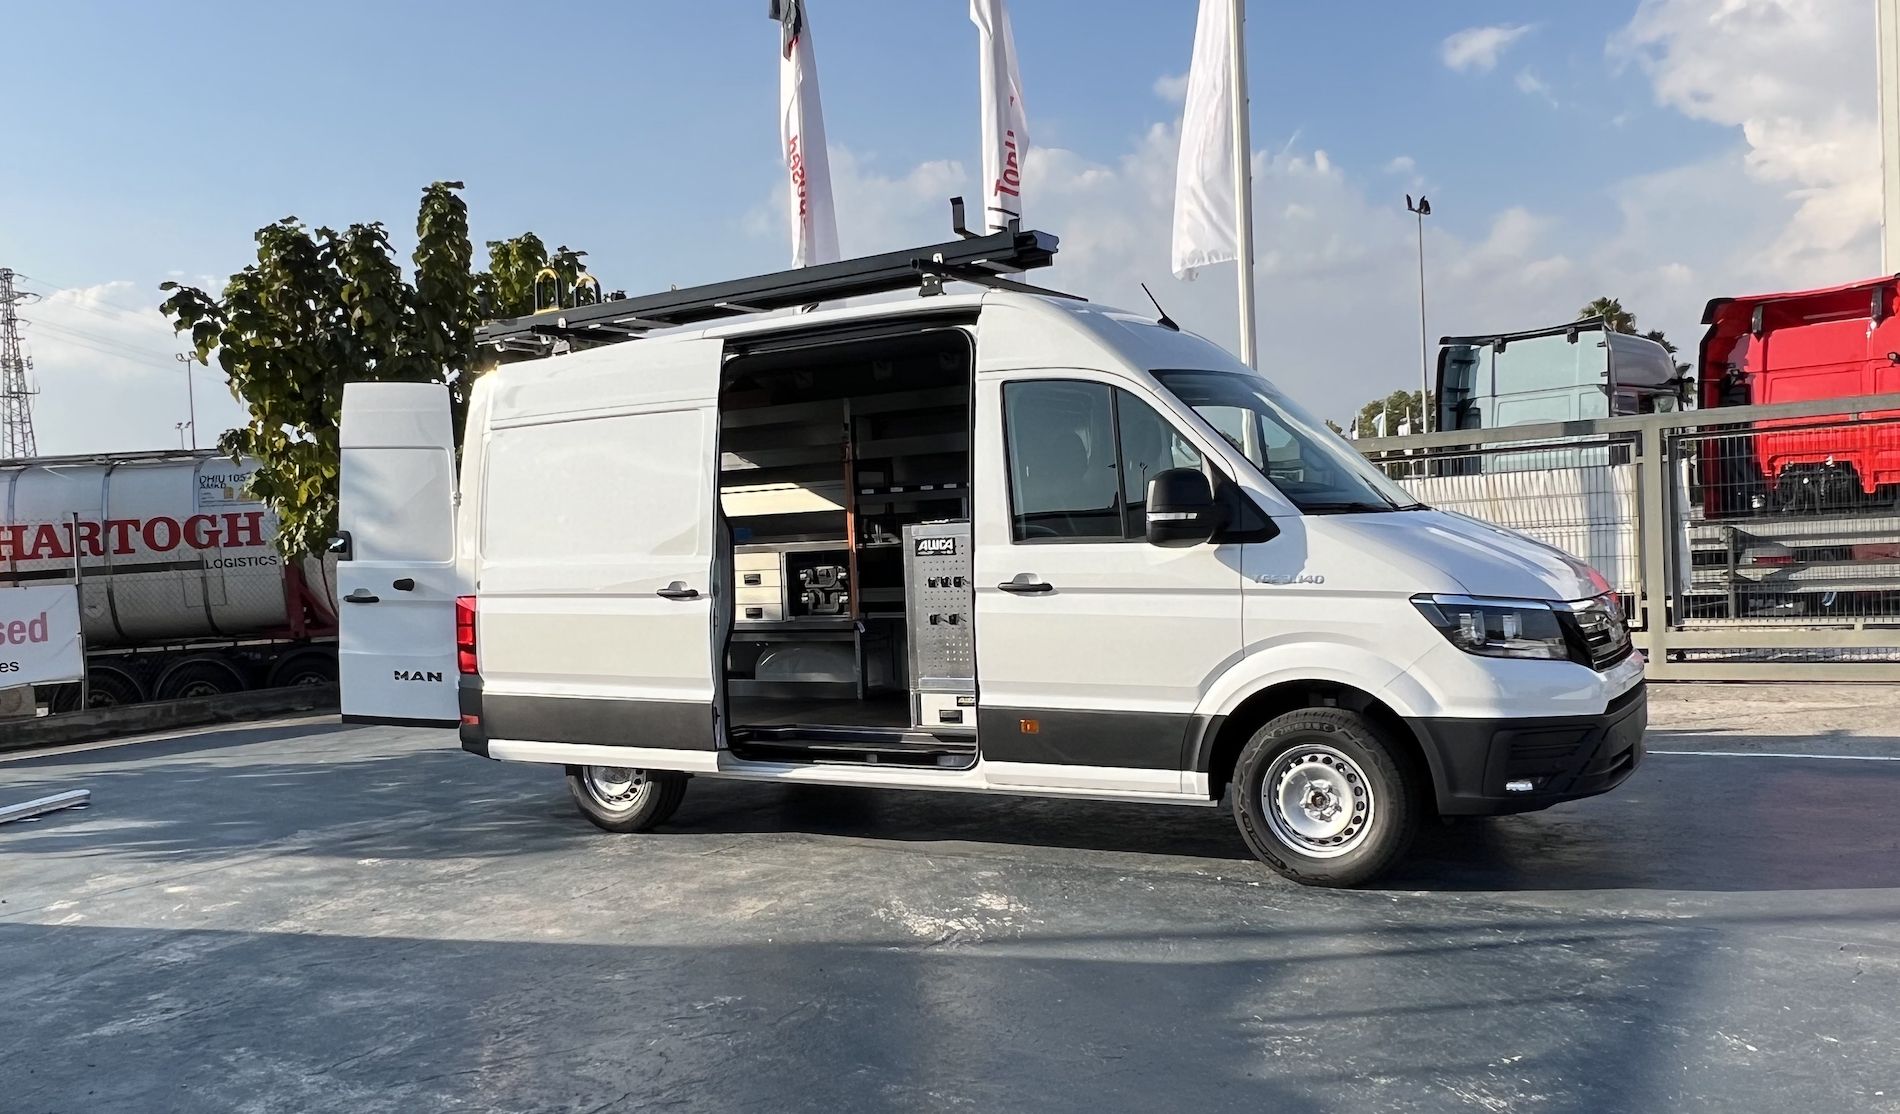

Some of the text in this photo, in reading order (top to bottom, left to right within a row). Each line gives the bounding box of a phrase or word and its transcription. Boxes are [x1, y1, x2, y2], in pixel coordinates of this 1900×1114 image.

[228, 473, 247, 483] 105
[0, 511, 266, 562] HARTOGH
[205, 555, 278, 569] LOGISTICS
[393, 670, 442, 682] MAN
